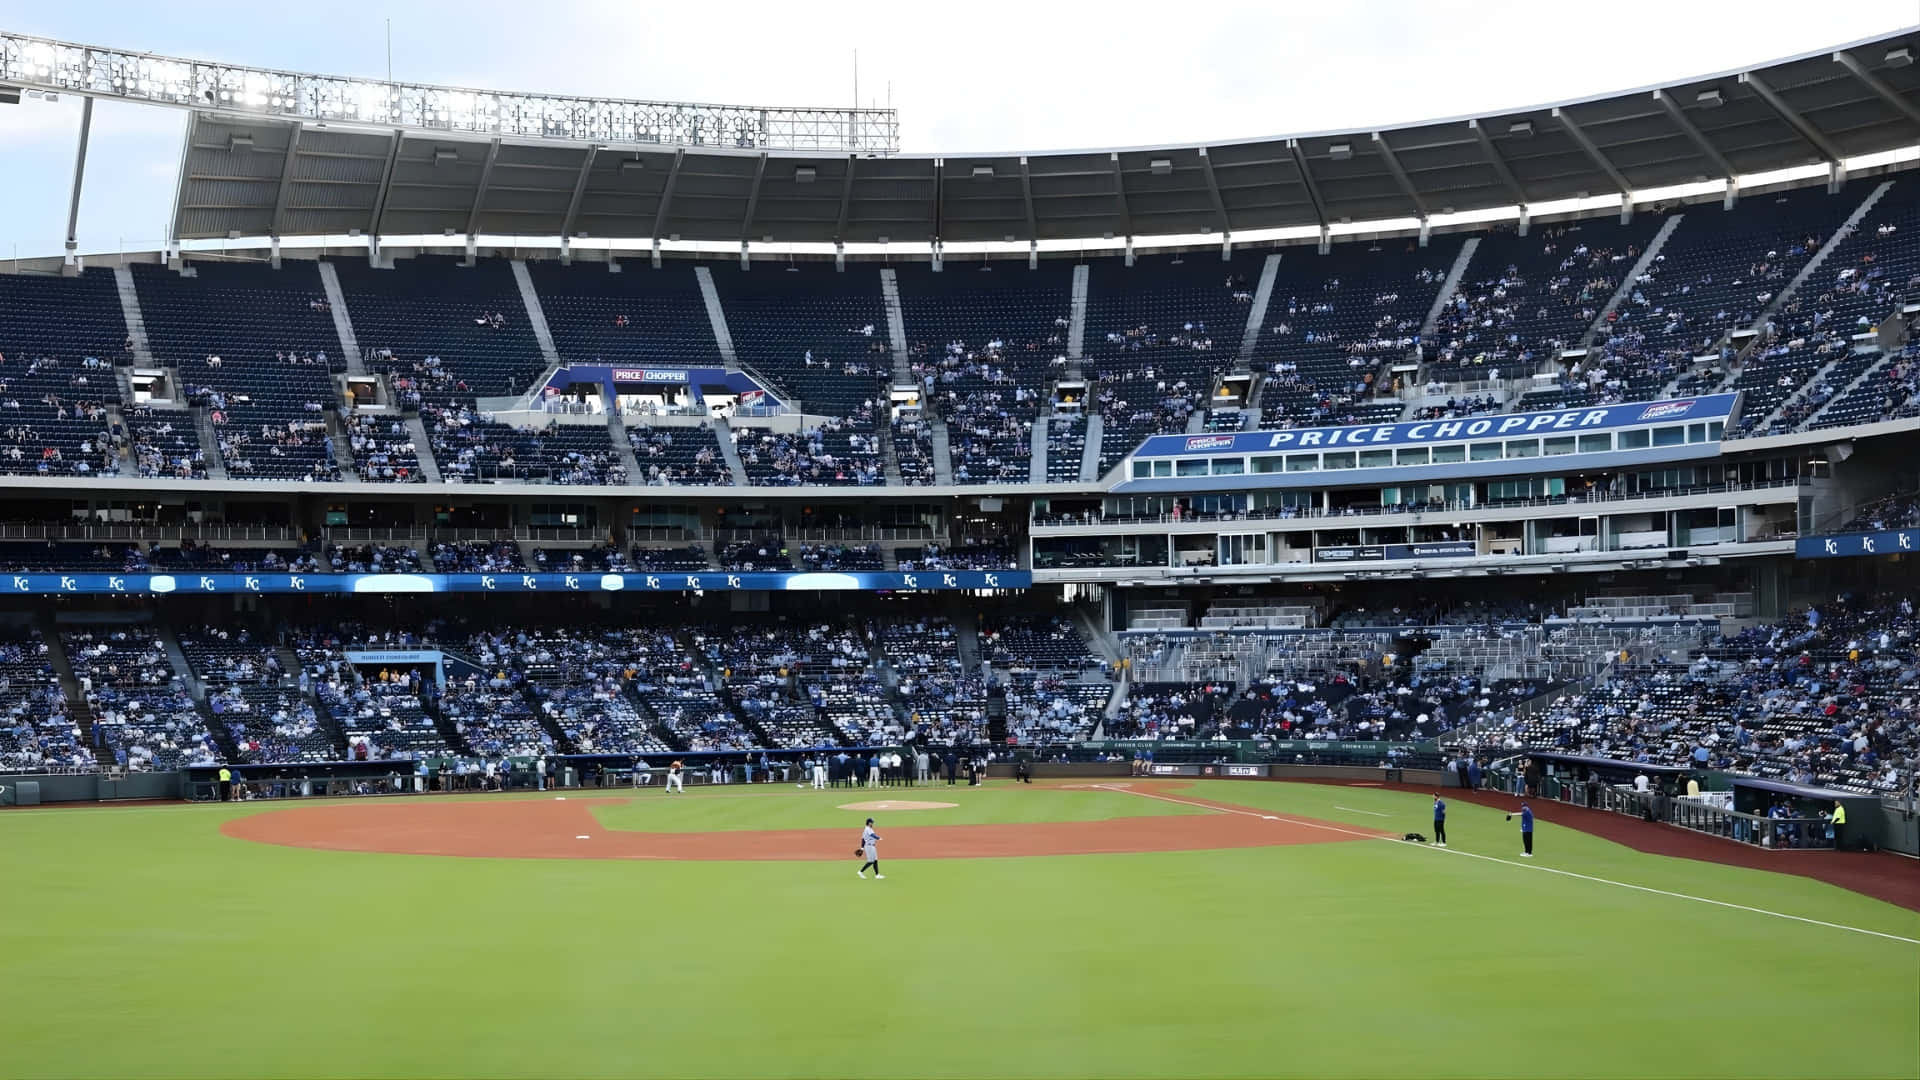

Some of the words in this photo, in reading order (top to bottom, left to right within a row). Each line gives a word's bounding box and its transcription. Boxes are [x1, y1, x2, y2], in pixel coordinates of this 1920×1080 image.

[615, 371, 642, 380] PRICE
[645, 371, 686, 381] CHOPPER
[1269, 427, 1394, 448] PRICE
[1407, 410, 1609, 440] CHOPPER
[1825, 539, 1838, 554] KC
[1863, 536, 1875, 552] KC
[1898, 533, 1911, 549] KC
[14, 576, 29, 591] KC
[61, 576, 76, 591] KC
[109, 576, 124, 591] KC
[200, 576, 215, 591] KC
[245, 576, 260, 591] KC
[290, 576, 304, 590] KC
[481, 576, 496, 590] KC
[523, 576, 537, 590] KC
[565, 576, 579, 590] KC
[646, 575, 660, 589] KC
[687, 575, 700, 589] KC
[727, 575, 741, 589] KC
[904, 575, 917, 588] KC
[943, 574, 957, 588] KC
[985, 574, 998, 587] KC
